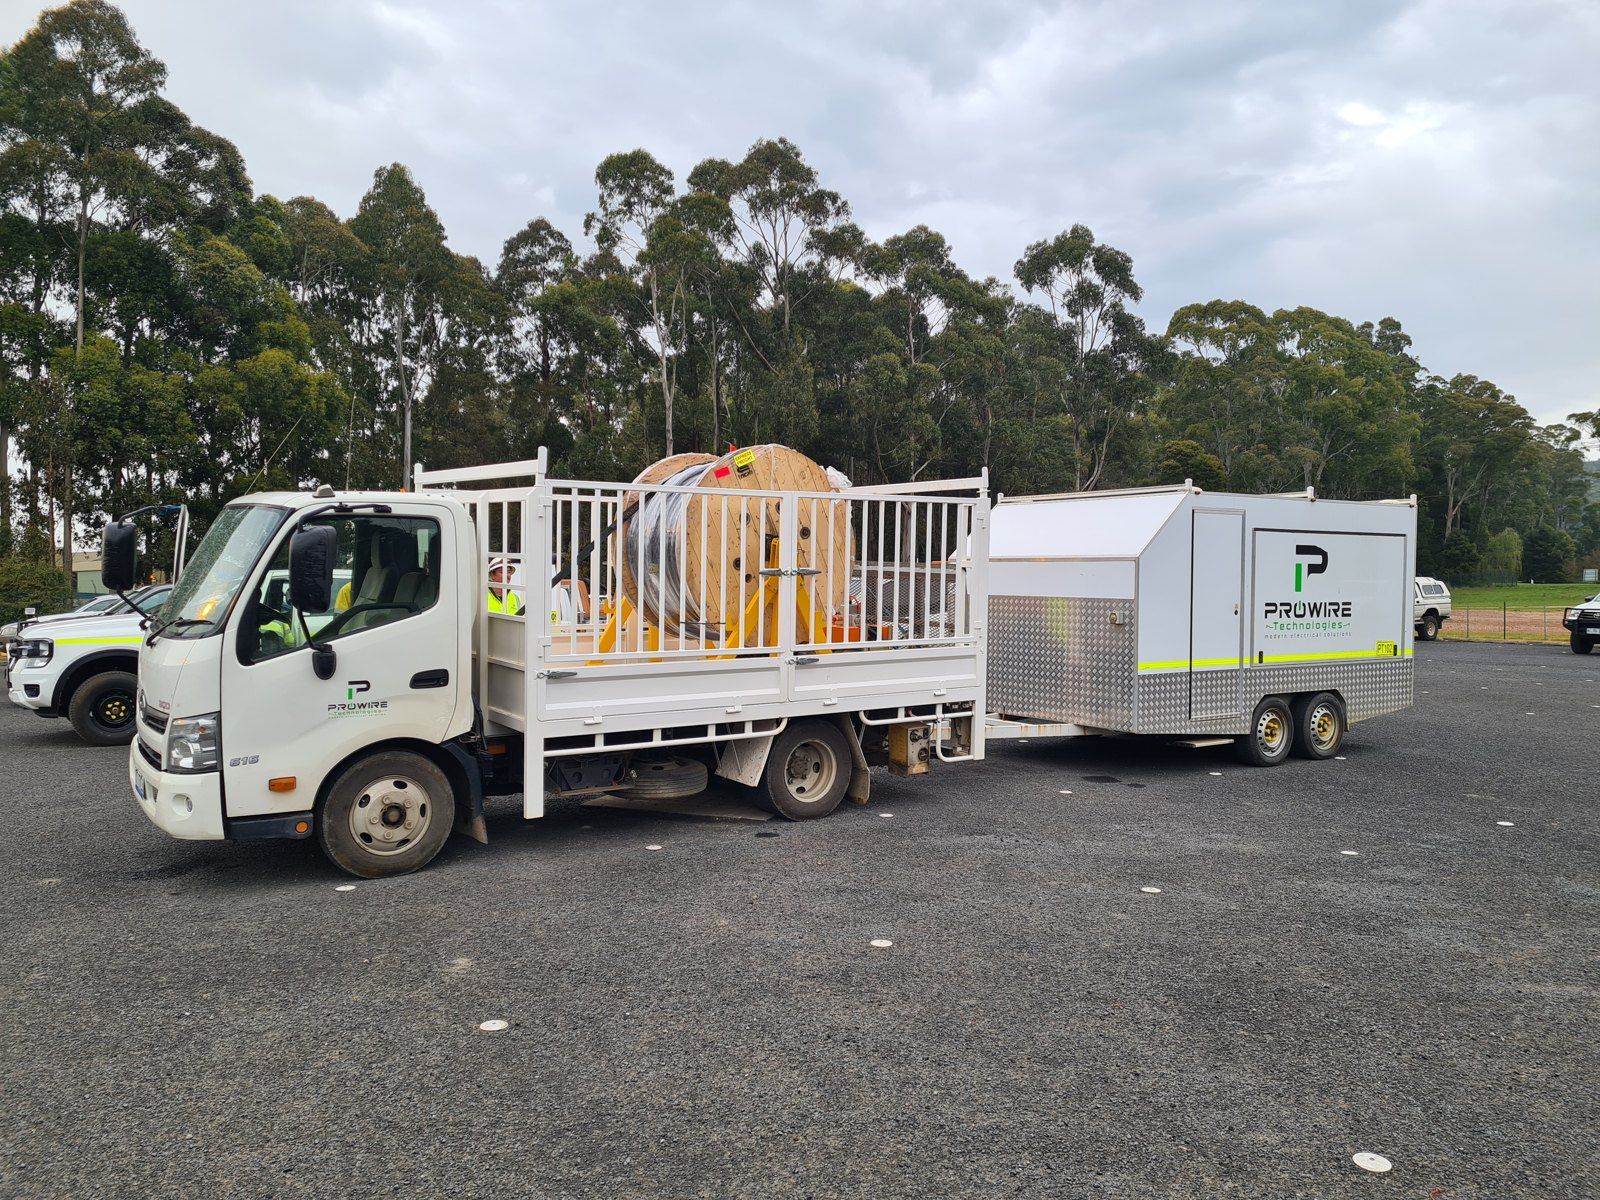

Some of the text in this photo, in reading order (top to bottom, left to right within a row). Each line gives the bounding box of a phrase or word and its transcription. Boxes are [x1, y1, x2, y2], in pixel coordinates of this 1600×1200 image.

[734, 450, 752, 461] EXPRESS
[736, 456, 753, 465] FREIGHT
[1264, 601, 1352, 619] PROWIRE
[1273, 621, 1343, 631] Technologies
[327, 701, 388, 711] PROWIRE
[229, 755, 260, 767] 616
